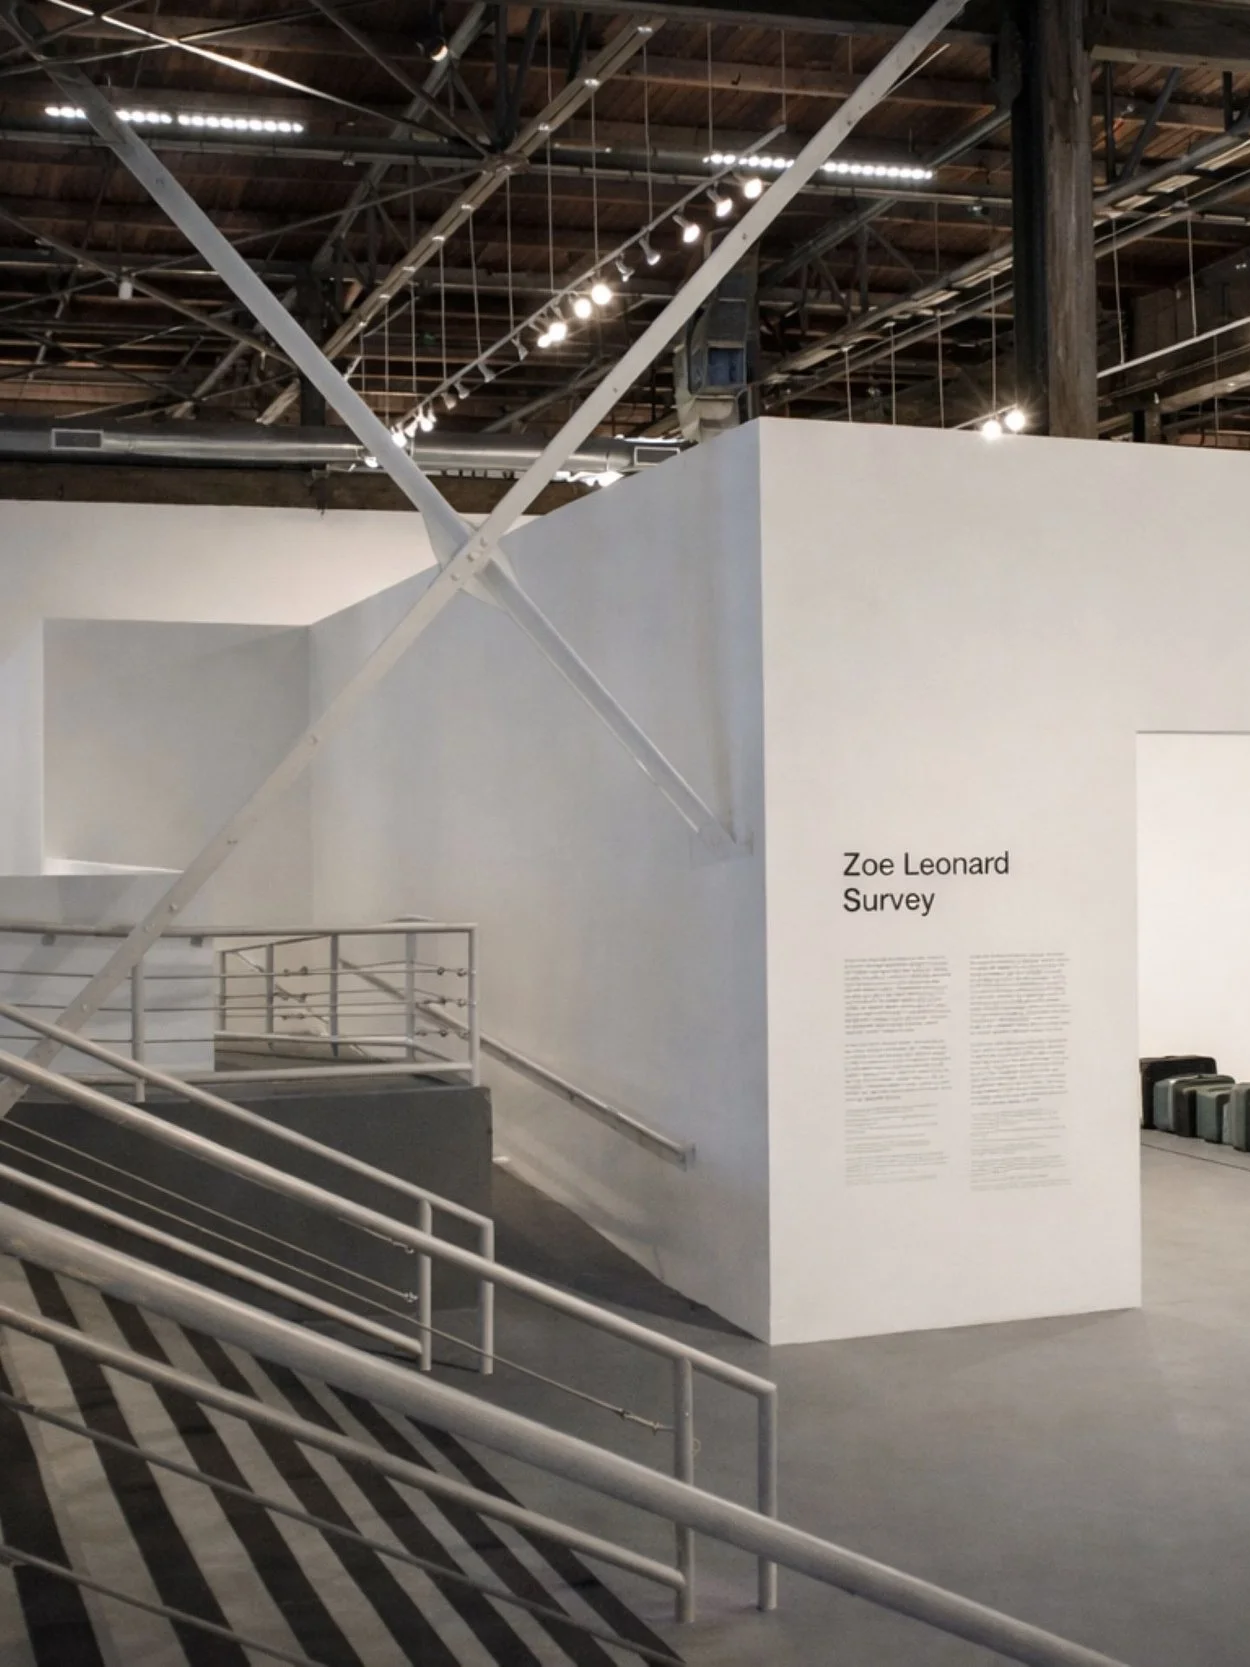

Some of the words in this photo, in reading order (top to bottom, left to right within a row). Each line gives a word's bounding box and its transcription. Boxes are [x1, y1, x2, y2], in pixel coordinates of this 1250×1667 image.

[843, 852, 895, 877] Zoe
[904, 850, 1010, 876] Leonard
[843, 887, 936, 917] Survey
